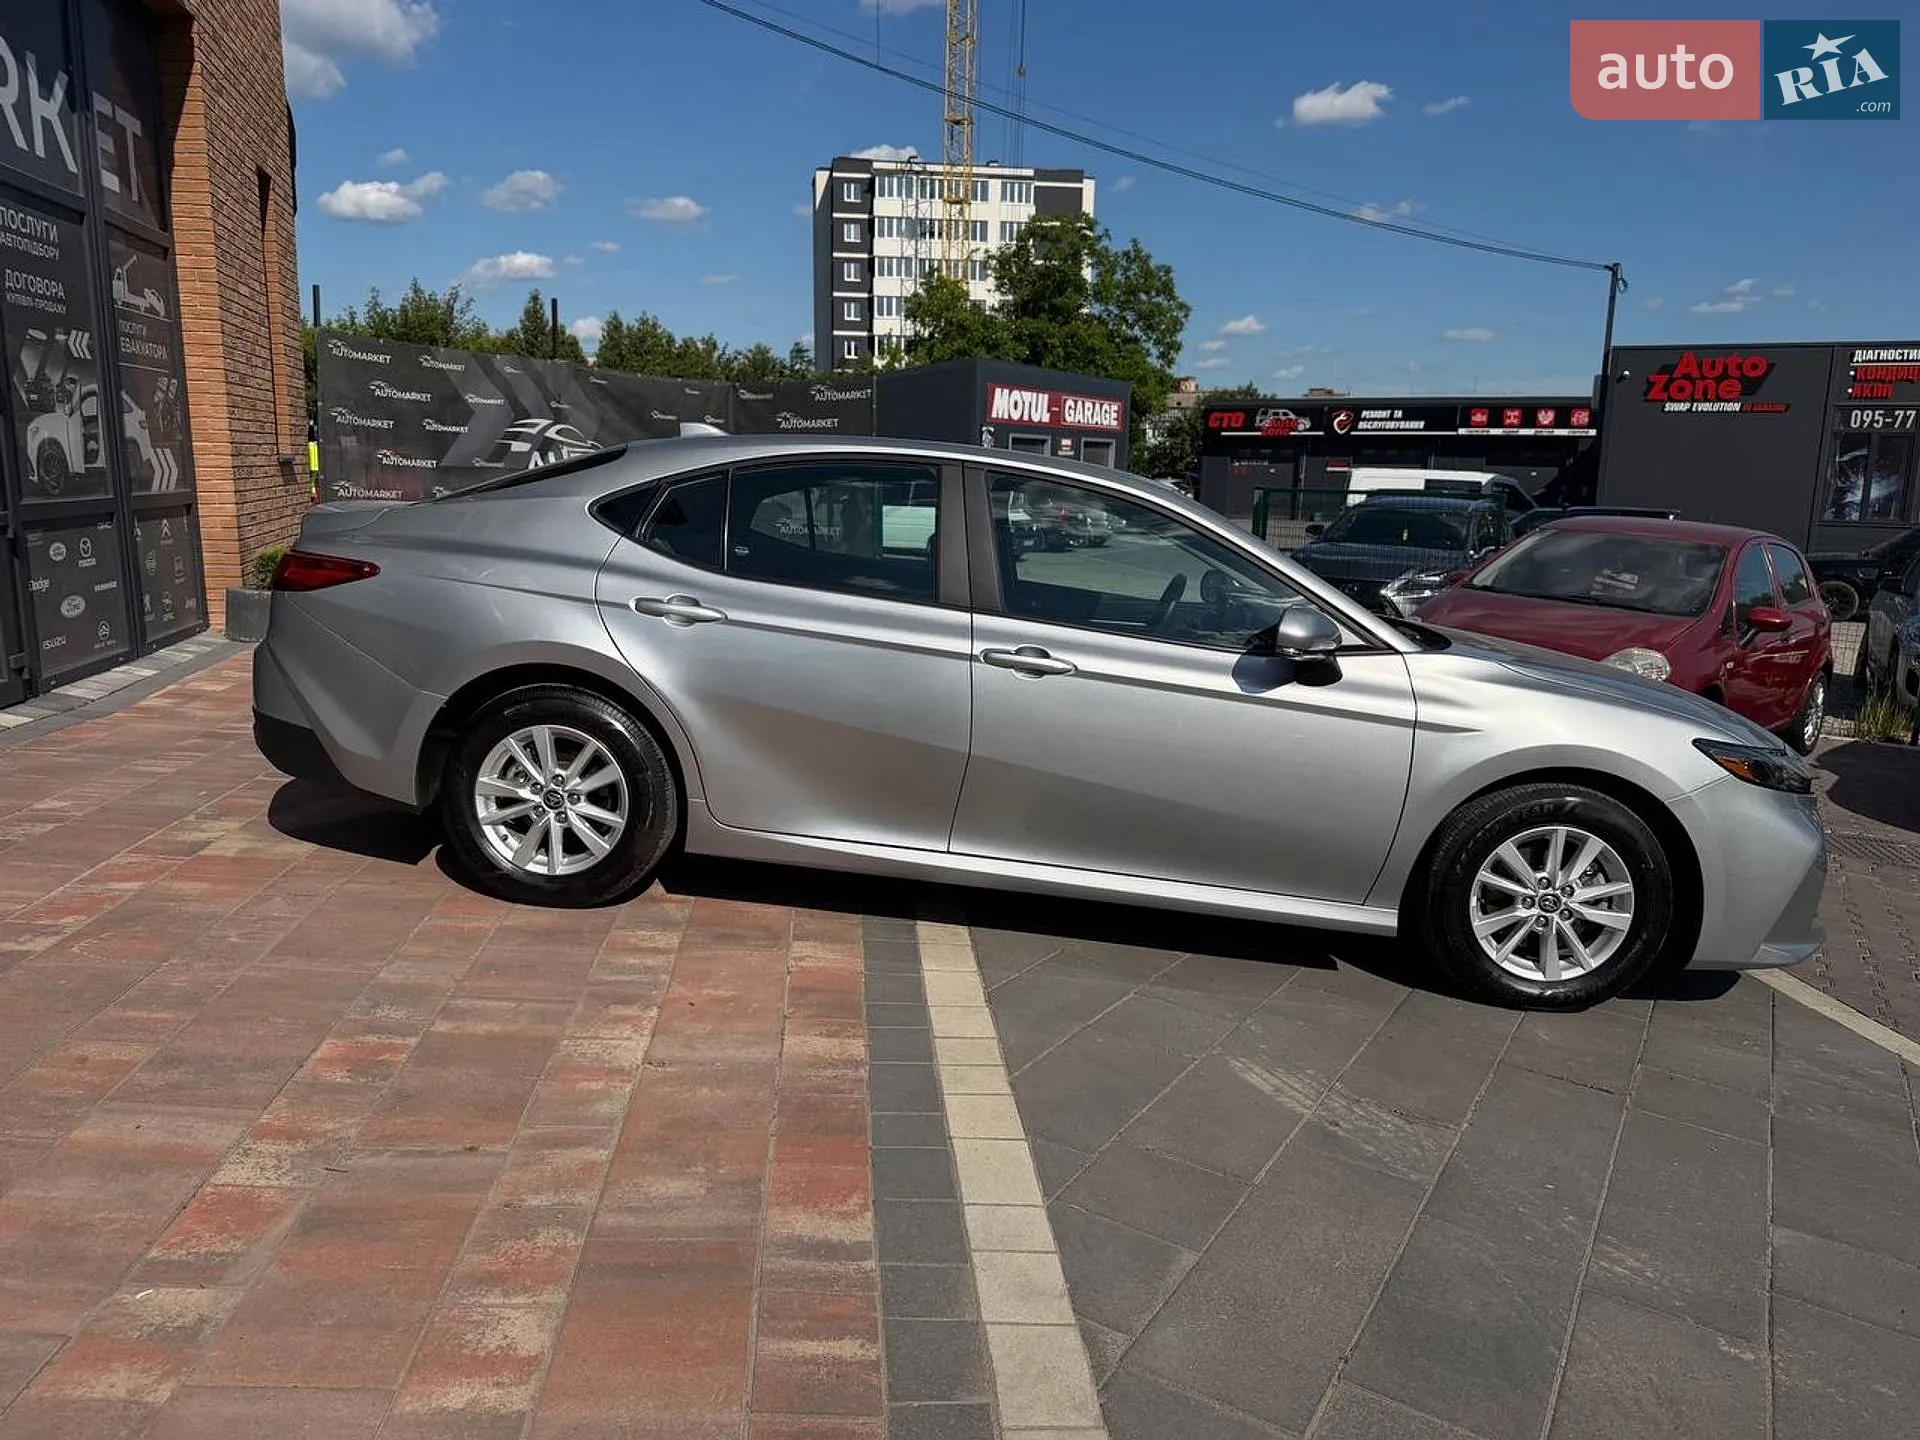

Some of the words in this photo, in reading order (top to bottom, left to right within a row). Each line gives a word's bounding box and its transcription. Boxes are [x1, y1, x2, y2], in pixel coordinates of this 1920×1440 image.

[332, 346, 392, 364] AUTOMARKET
[1673, 351, 1768, 378] Auto
[814, 388, 872, 401] AUTOMARKET
[1646, 374, 1742, 401] Zone
[374, 388, 432, 402] AUTOMARKET
[991, 387, 1051, 423] MOTUL
[1064, 399, 1119, 426] GARAGE
[1691, 401, 1741, 412] EVOLUTION
[335, 415, 395, 429] AUTOMARKET
[779, 418, 839, 429] AUTOMARKET
[1850, 409, 1917, 429] 095-77
[382, 457, 438, 468] AUTOMARKET
[337, 487, 404, 499] AUTOMARKET
